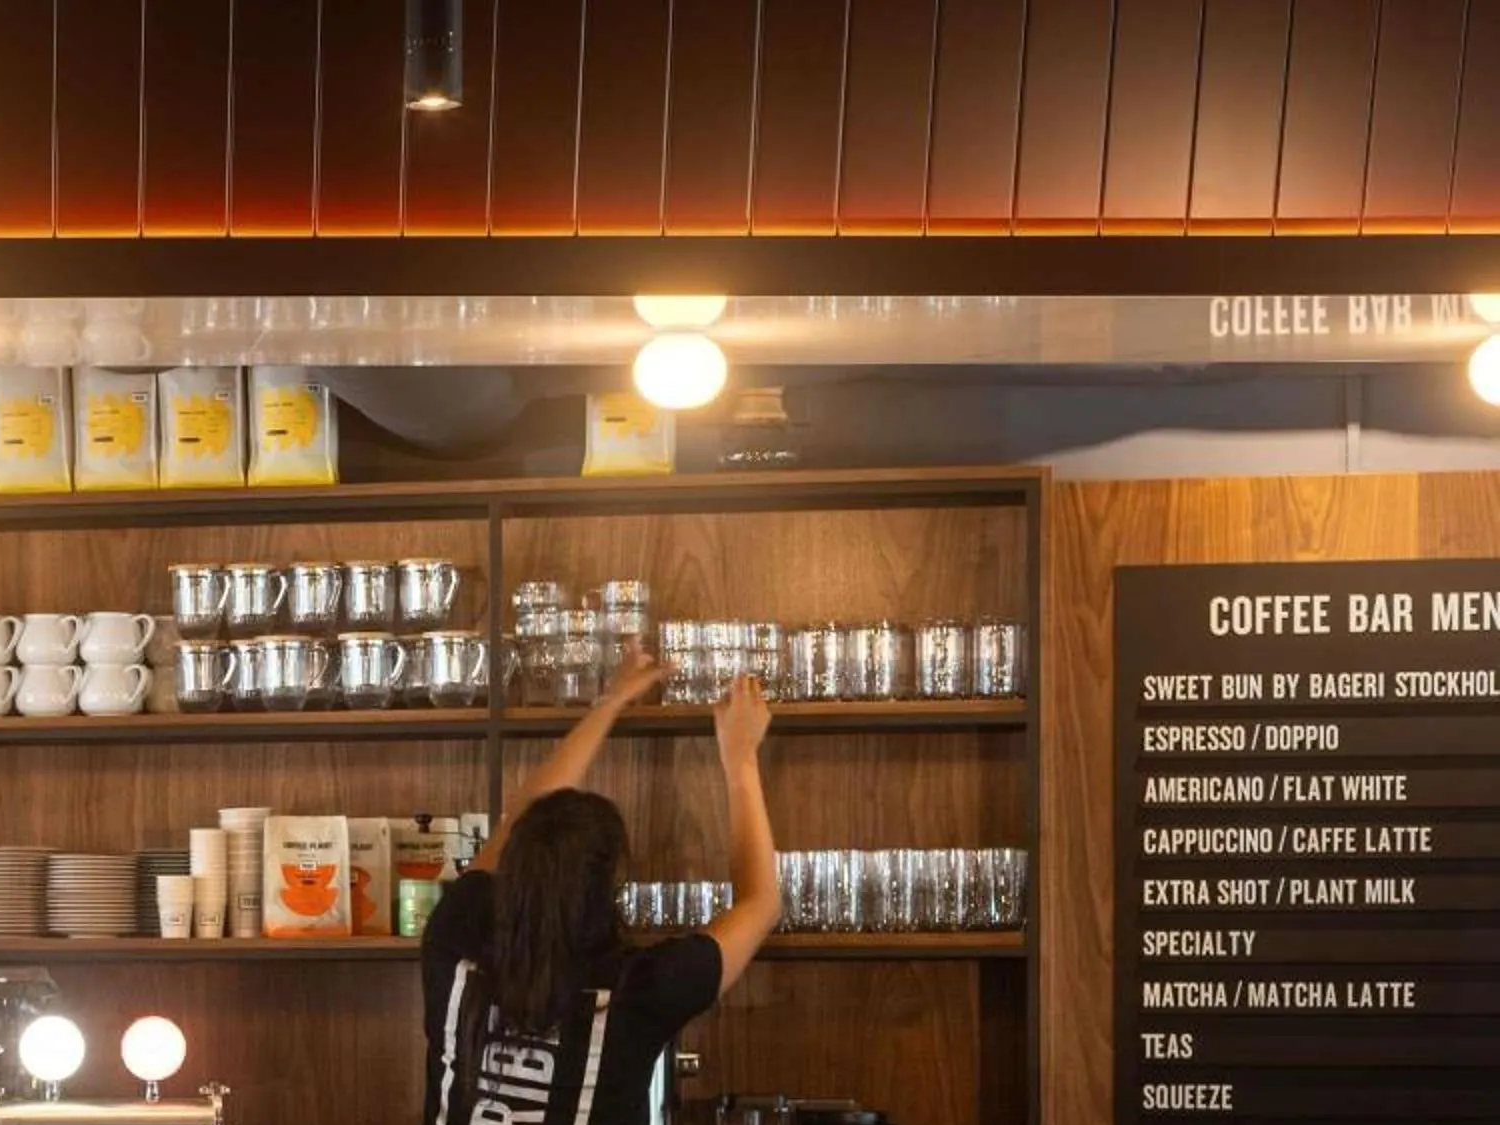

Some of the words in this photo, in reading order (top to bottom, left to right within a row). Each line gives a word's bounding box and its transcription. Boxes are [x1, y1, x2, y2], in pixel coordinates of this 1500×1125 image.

[1210, 594, 1331, 636] COFFEE
[1349, 593, 1413, 633] BAR
[1143, 675, 1213, 701] SWEET
[1221, 674, 1263, 700] BUN
[1273, 673, 1300, 699] BY
[1309, 672, 1385, 698] BAGERI
[1144, 725, 1246, 752] ESPRESSO
[1251, 723, 1261, 751] /
[1265, 724, 1339, 751] DOPPIO
[1145, 776, 1264, 803] AMERICANO
[1269, 774, 1279, 801] /
[1283, 775, 1335, 801] FLAT
[1341, 775, 1407, 801] WHITE
[1143, 827, 1273, 854] CAPPUCCINO
[1278, 825, 1288, 853] /
[1293, 827, 1357, 853] CAFFE
[1365, 826, 1432, 853] LATTE
[1143, 879, 1210, 905] EXTRA
[1217, 879, 1270, 905] SHOT
[1275, 877, 1285, 904] /
[1290, 879, 1357, 905] PLANT
[1365, 878, 1415, 904] MILK
[1143, 930, 1255, 956] SPECIALTY
[1143, 982, 1227, 1007] MATCHA
[1233, 980, 1243, 1008] /
[1248, 982, 1337, 1008] MATCHA
[1347, 982, 1415, 1008] LATTE
[1141, 1033, 1193, 1059] TEAS
[1143, 1084, 1233, 1110] SQUEEZE
